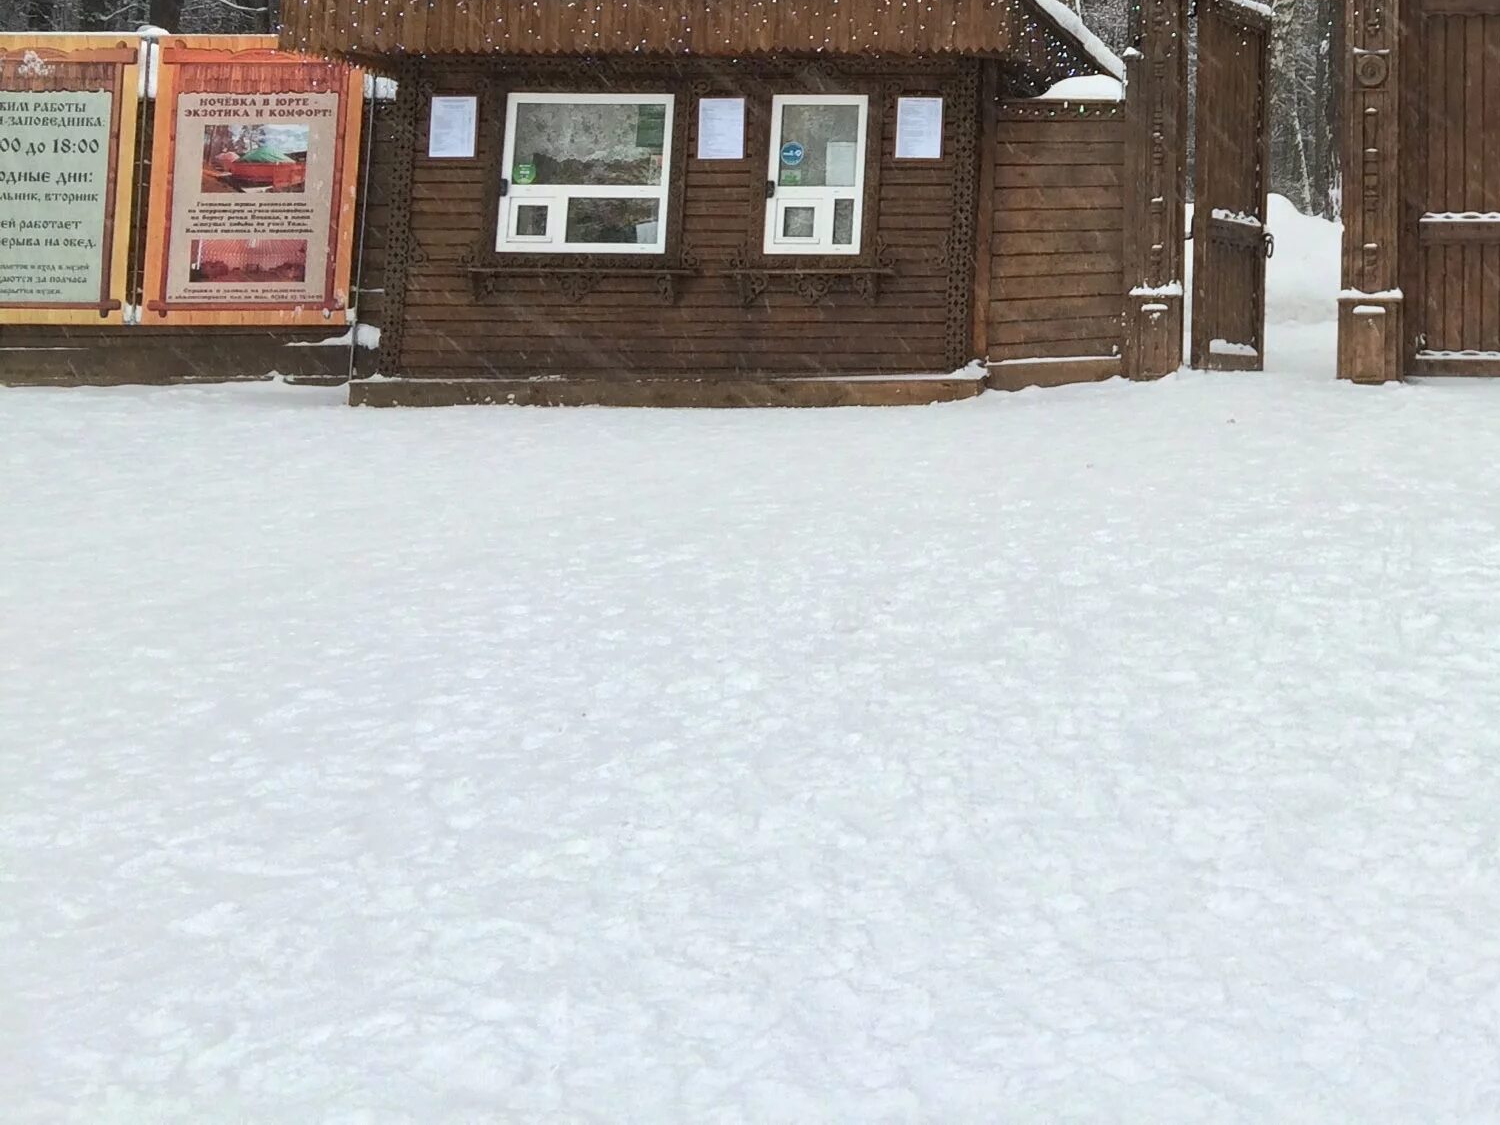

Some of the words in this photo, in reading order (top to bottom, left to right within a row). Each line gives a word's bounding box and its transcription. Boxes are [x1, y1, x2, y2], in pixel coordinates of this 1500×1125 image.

[199, 97, 257, 107] НОЧЁВКА
[262, 98, 270, 106] В
[276, 98, 310, 107] ЮРТЕ
[33, 102, 87, 113] РАБОТЫ
[184, 109, 250, 117] ЭКЗОТИКА
[255, 109, 264, 117] И
[269, 108, 332, 117] КОМФОРТ!
[53, 138, 100, 154] 18:00
